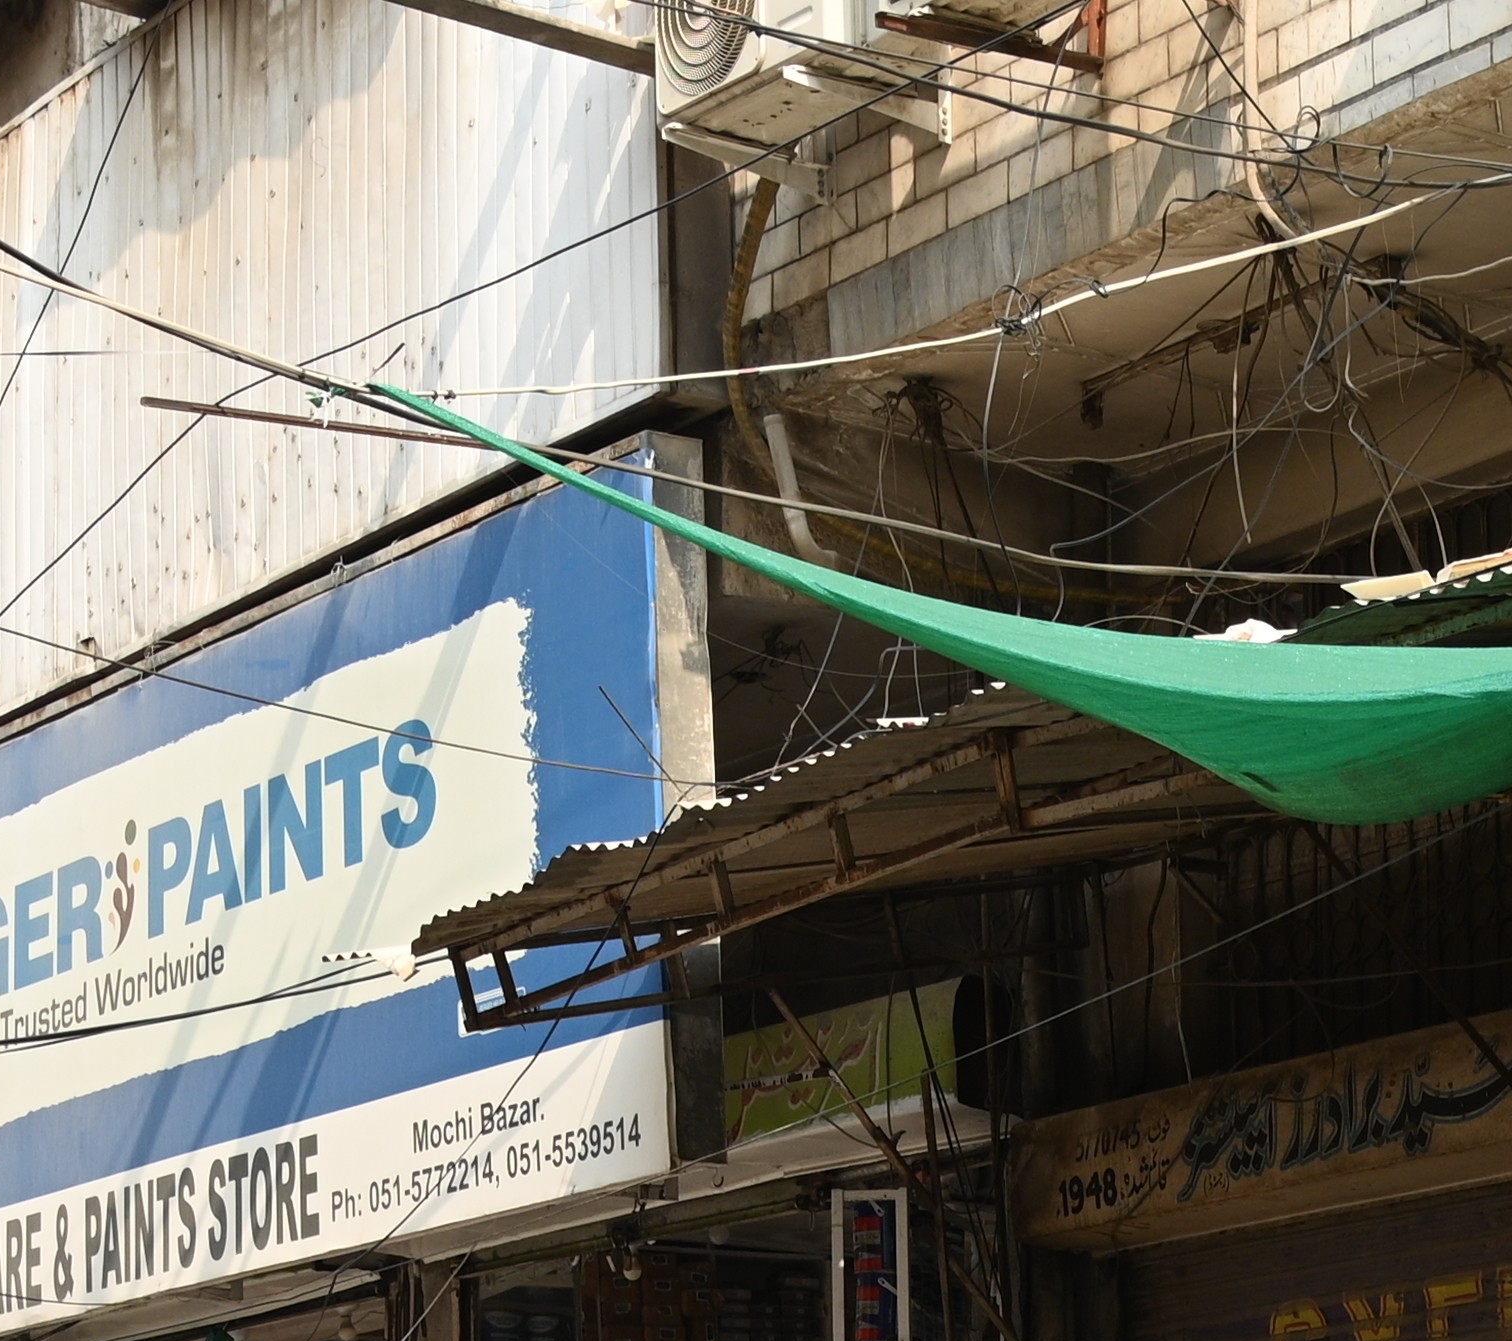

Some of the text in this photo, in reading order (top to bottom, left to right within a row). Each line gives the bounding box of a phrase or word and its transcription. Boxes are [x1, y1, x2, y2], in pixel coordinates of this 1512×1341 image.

[147, 718, 438, 940] PAINTS
[0, 937, 226, 1050] Trusted Worldwide
[331, 1113, 642, 1223] Ph: 051-5772214, 051-5539514
[412, 1096, 545, 1154] Mochi Bazar.
[53, 1204, 75, 1302] &
[85, 1165, 197, 1294] PAINTS
[207, 1133, 320, 1262] STORE
